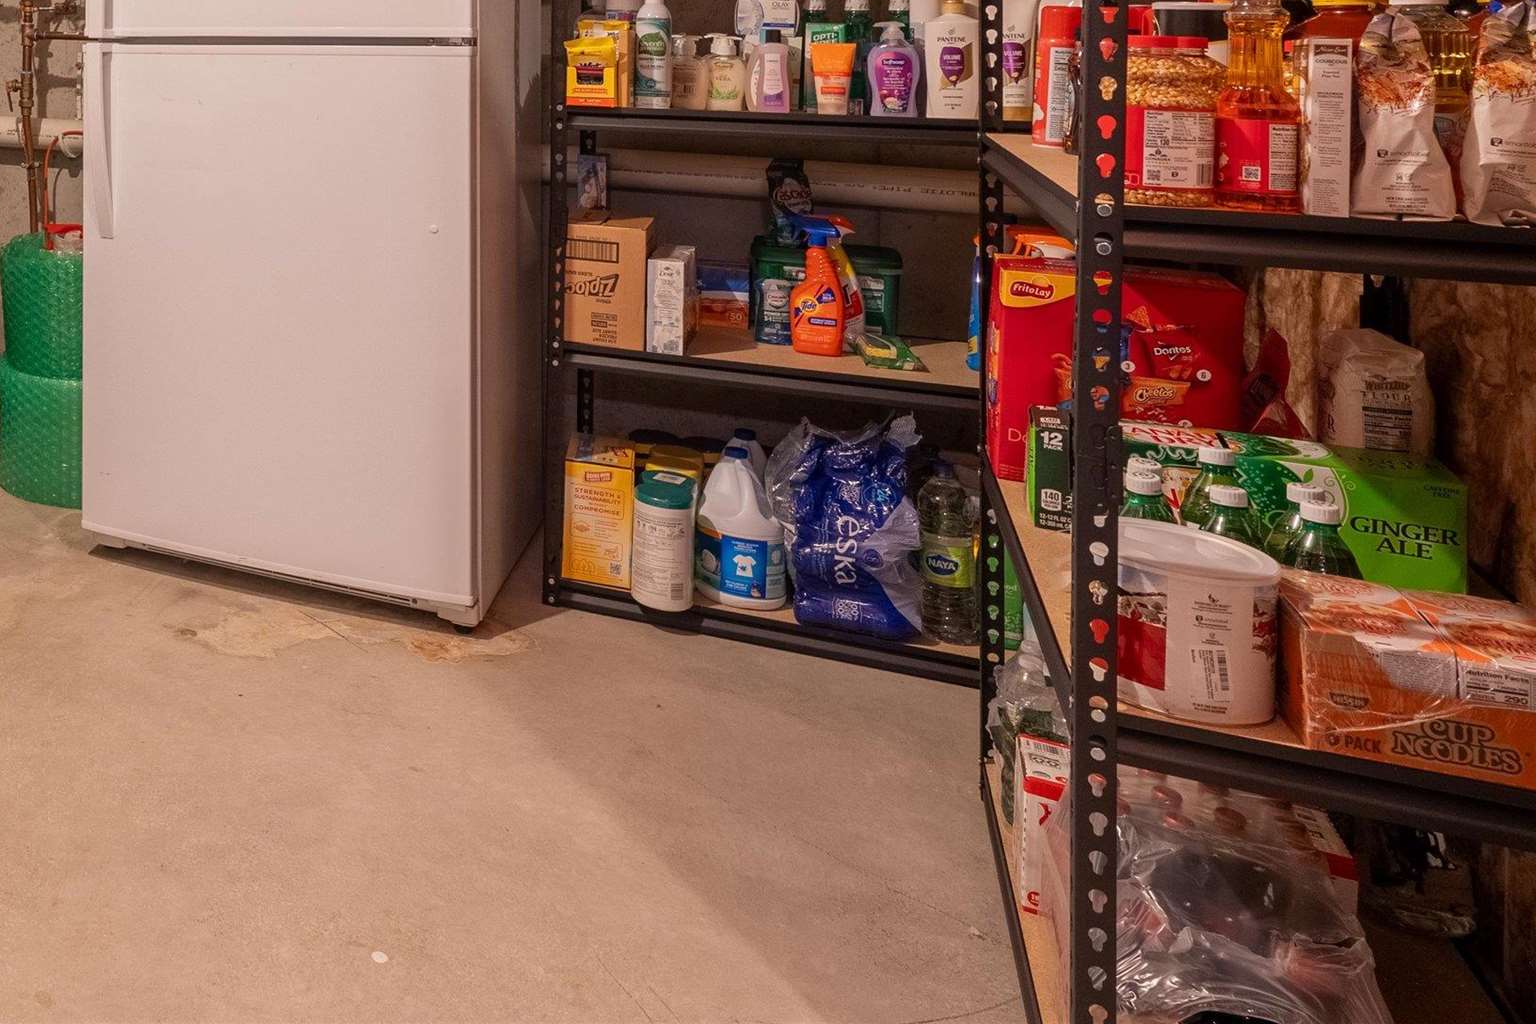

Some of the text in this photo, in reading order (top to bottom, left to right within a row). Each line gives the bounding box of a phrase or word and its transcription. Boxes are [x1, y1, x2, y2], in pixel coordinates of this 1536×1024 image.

[566, 274, 619, 297] Ziploc
[800, 300, 817, 311] Tide
[728, 313, 743, 321] 50
[1154, 345, 1192, 356] Doritos
[1134, 386, 1175, 403] Cheetos
[1040, 431, 1063, 444] 12
[1044, 443, 1063, 451] PACK
[574, 487, 615, 498] STRENGTH
[1424, 484, 1460, 493] CAFFEINE
[1044, 491, 1059, 501] 140
[574, 504, 620, 516] COMPROMISE
[1349, 516, 1461, 546] GINGER
[834, 515, 860, 585] eska
[1376, 538, 1433, 560] ALE
[928, 558, 956, 571] NAYA
[1421, 719, 1495, 746] CUP
[1345, 735, 1381, 753] PACK
[1392, 731, 1522, 775] NOODLES
